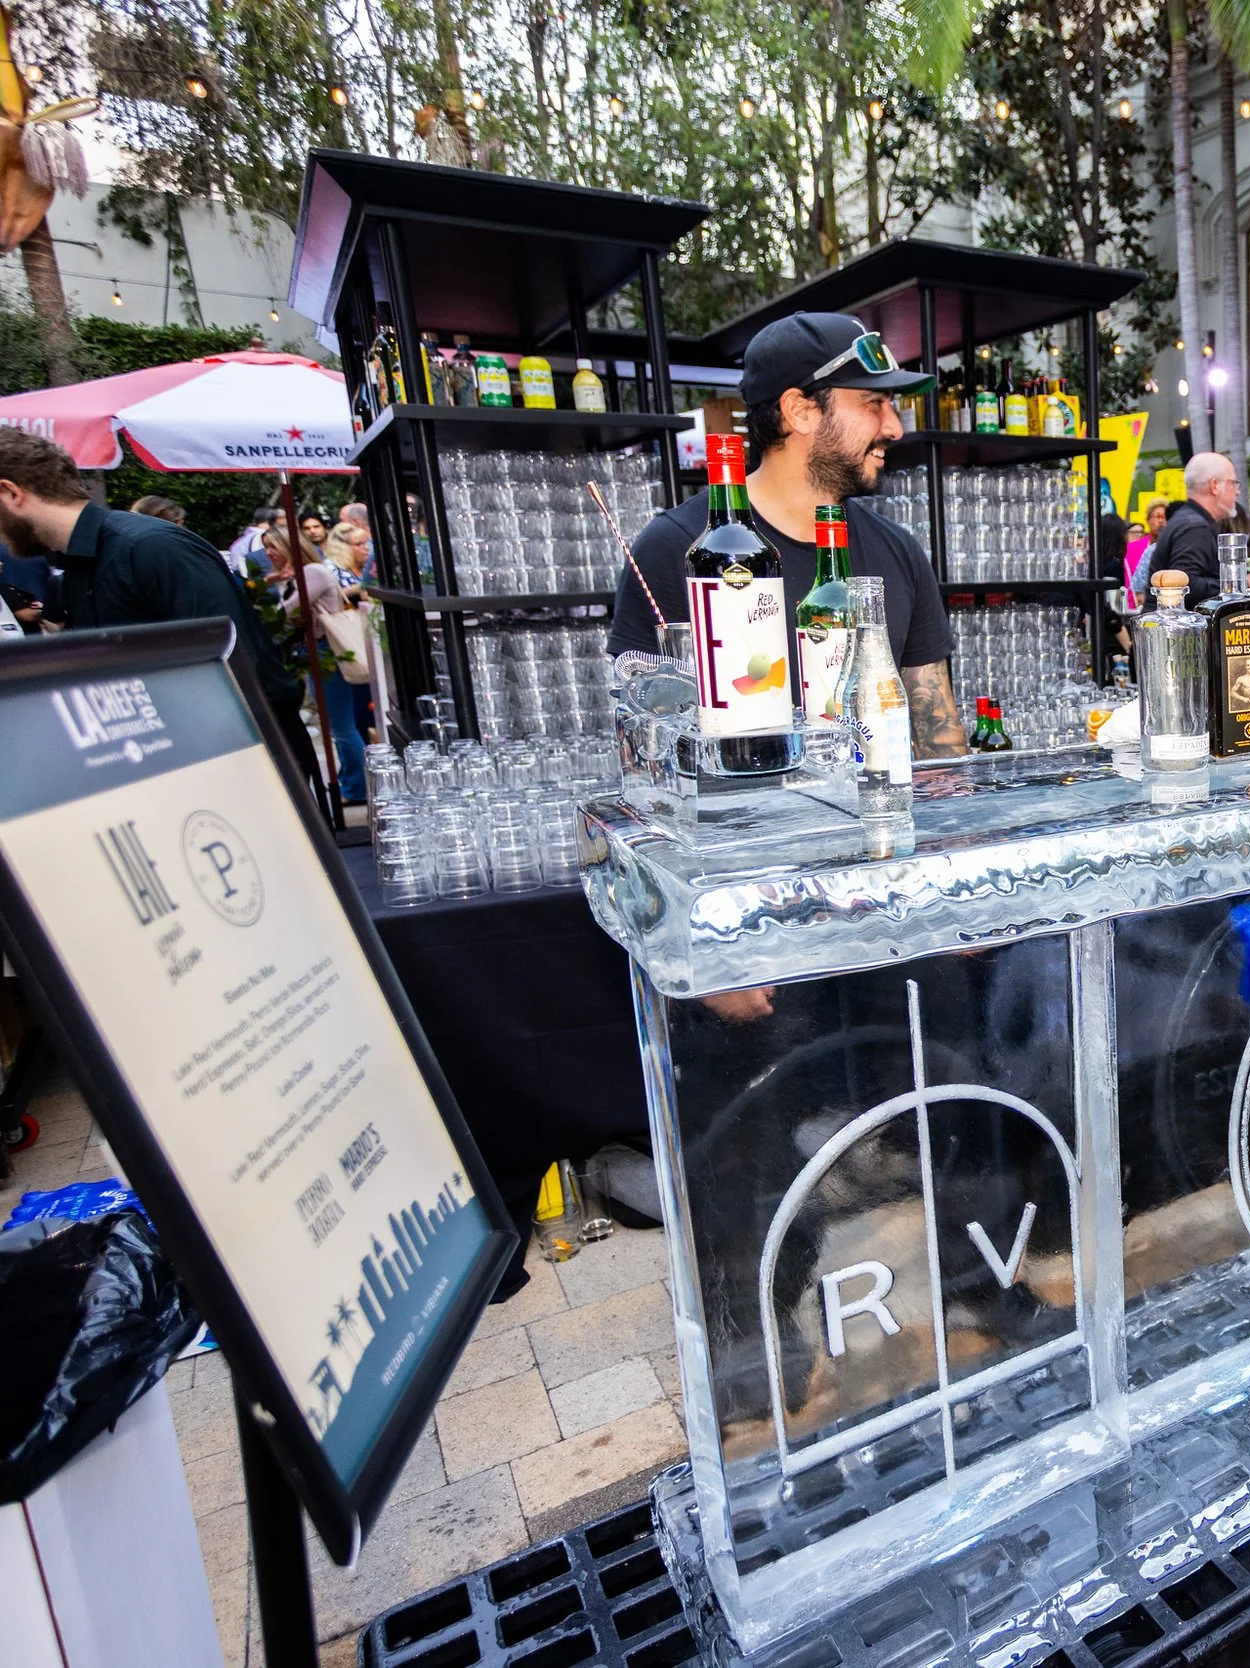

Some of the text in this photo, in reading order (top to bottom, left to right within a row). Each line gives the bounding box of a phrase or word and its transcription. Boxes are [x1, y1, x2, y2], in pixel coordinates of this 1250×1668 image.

[225, 445, 353, 458] SANPELLEGRIN
[757, 592, 774, 606] RED
[1225, 646, 1243, 655] HARD
[53, 687, 111, 750] LA
[86, 679, 136, 723] CHEF
[95, 819, 180, 926] LAIE
[201, 841, 239, 899] P
[966, 1202, 1038, 1290] V
[821, 1259, 901, 1357] R
